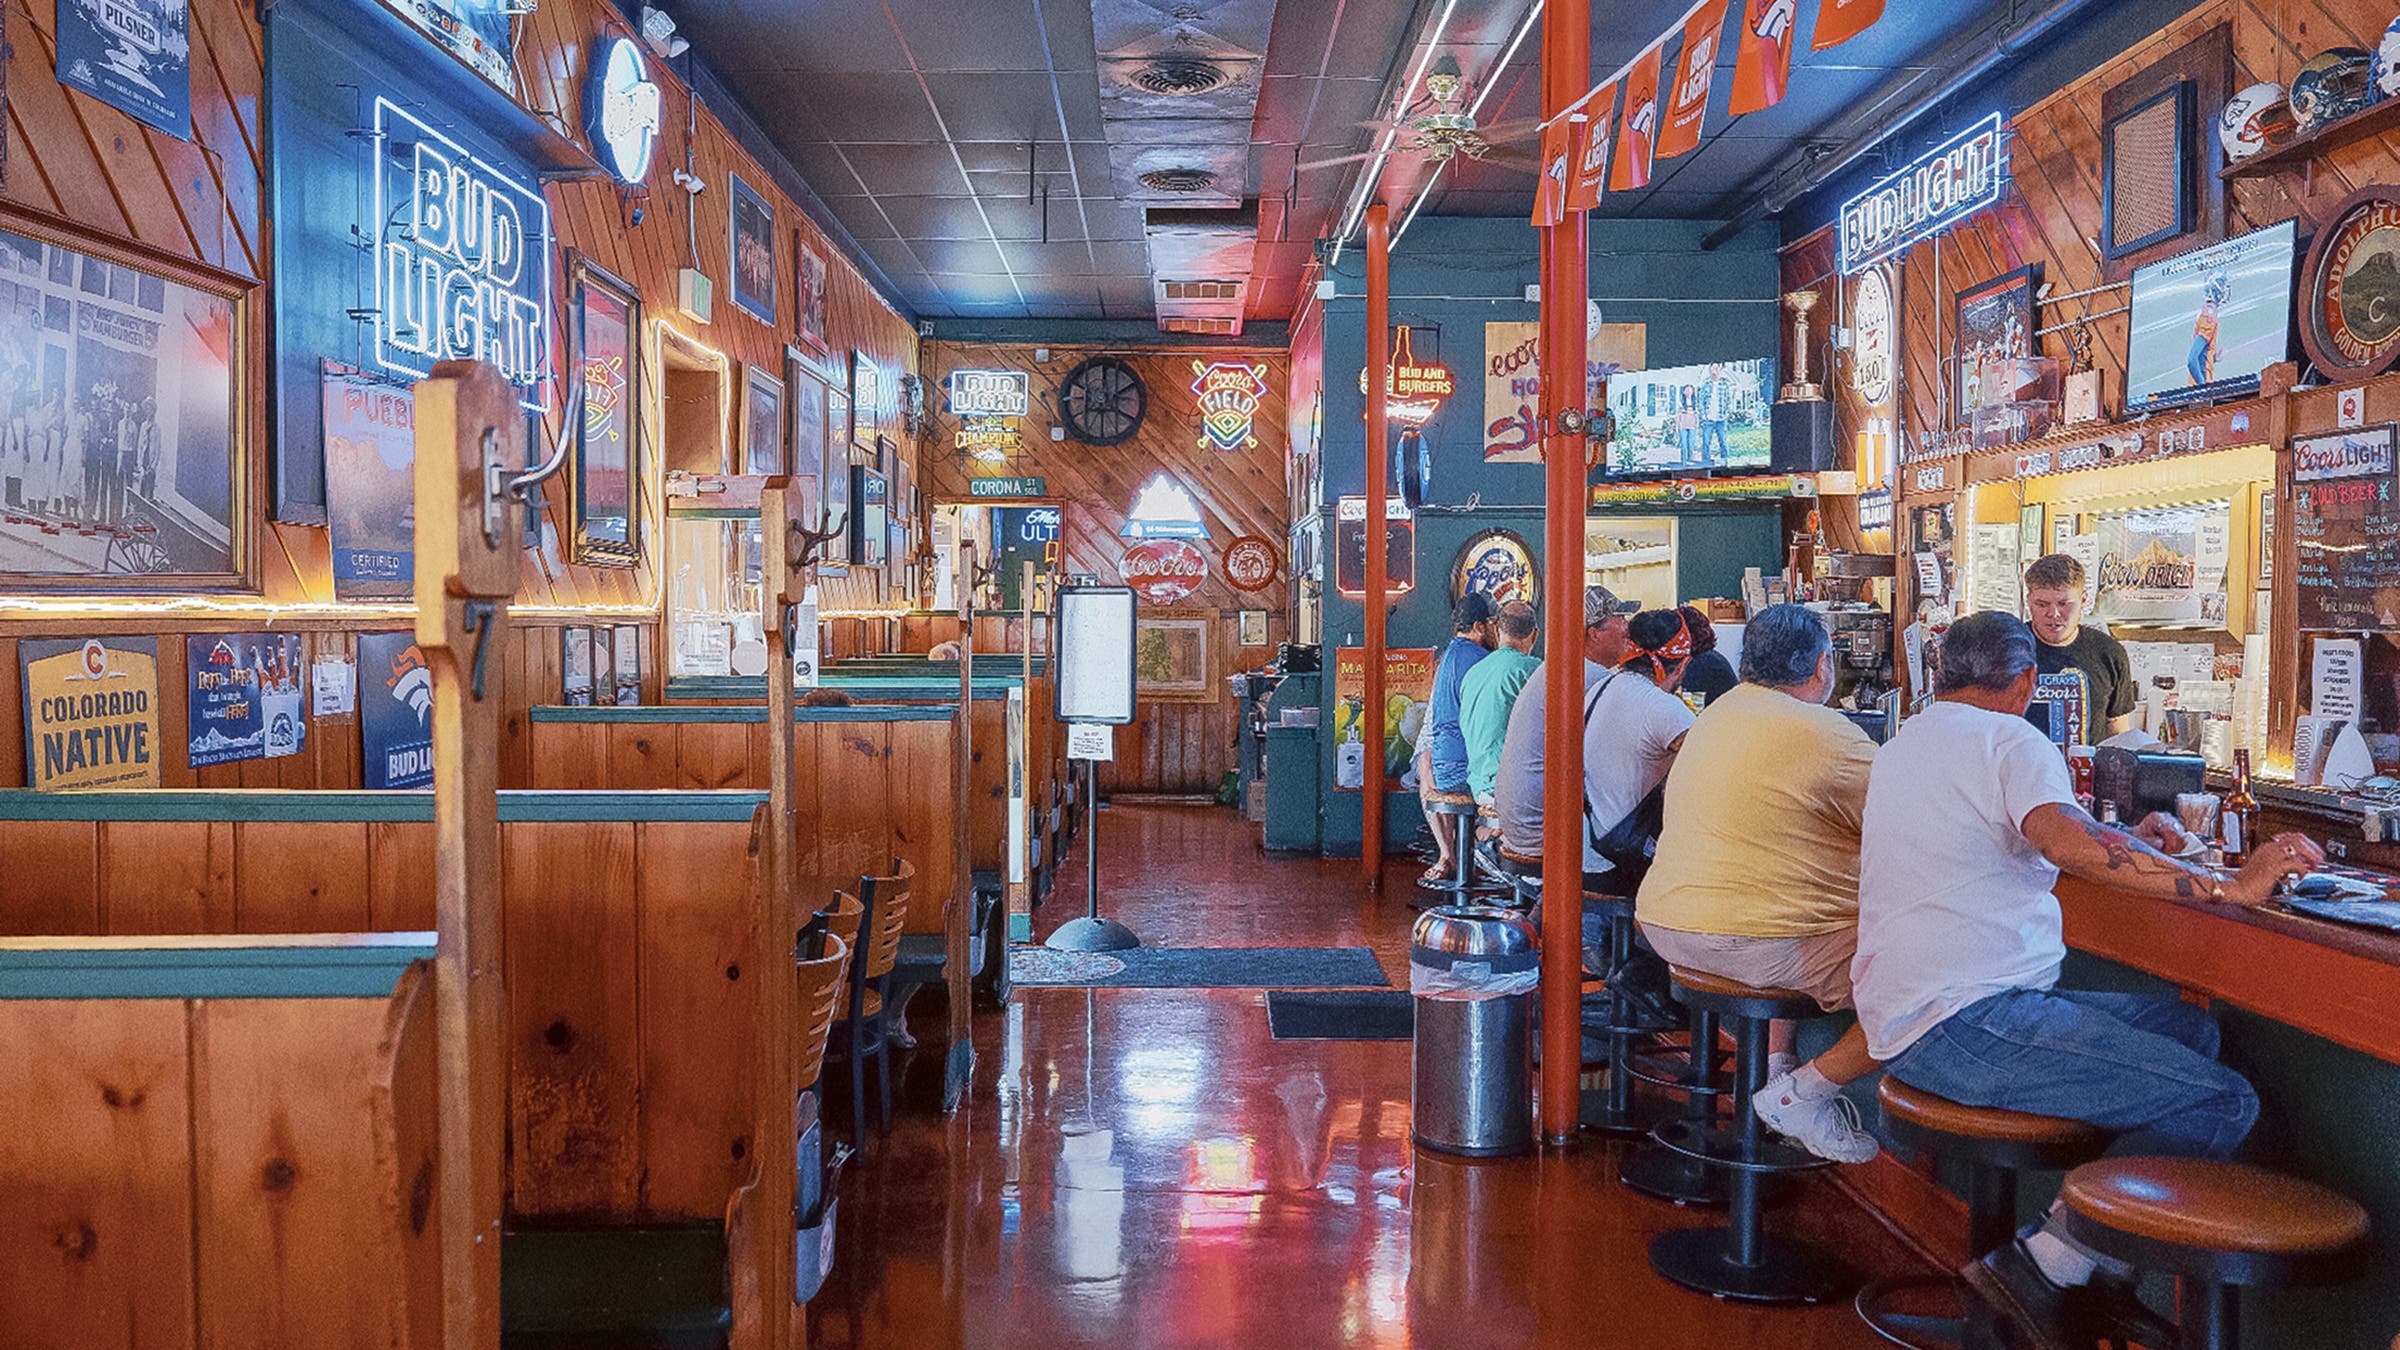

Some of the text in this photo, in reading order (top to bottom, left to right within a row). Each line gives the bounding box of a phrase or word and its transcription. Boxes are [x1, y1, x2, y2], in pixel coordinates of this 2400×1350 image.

[105, 5, 156, 46] PILSNER
[1691, 36, 1712, 73] BUD
[1845, 131, 1993, 261] BUD LIGHT
[415, 142, 523, 286] BUD
[2326, 207, 2385, 303] ADOLPH
[389, 243, 540, 384] LIGHT
[2334, 327, 2371, 361] GOLDEN
[966, 375, 1016, 393] BUD
[1399, 367, 1445, 380] BUD AND
[1399, 381, 1452, 394] BURGERS
[344, 385, 416, 431] PUEBL
[1204, 390, 1253, 414] FIELD
[955, 431, 1023, 448] CHAMPIONS
[2294, 443, 2390, 472] Coors LIGHT
[971, 480, 1022, 495] CORONA
[2310, 483, 2378, 506] COLD BEER
[1021, 525, 1058, 541] ULT
[351, 553, 400, 568] CERTIFIED
[1130, 552, 1198, 576] Coors
[2098, 551, 2141, 590] Coors
[1341, 662, 1427, 675] MAARITA
[2034, 685, 2079, 700] Coors
[41, 690, 148, 724] COLORADO
[43, 722, 150, 781] NATIVE
[389, 751, 419, 779] BUD
